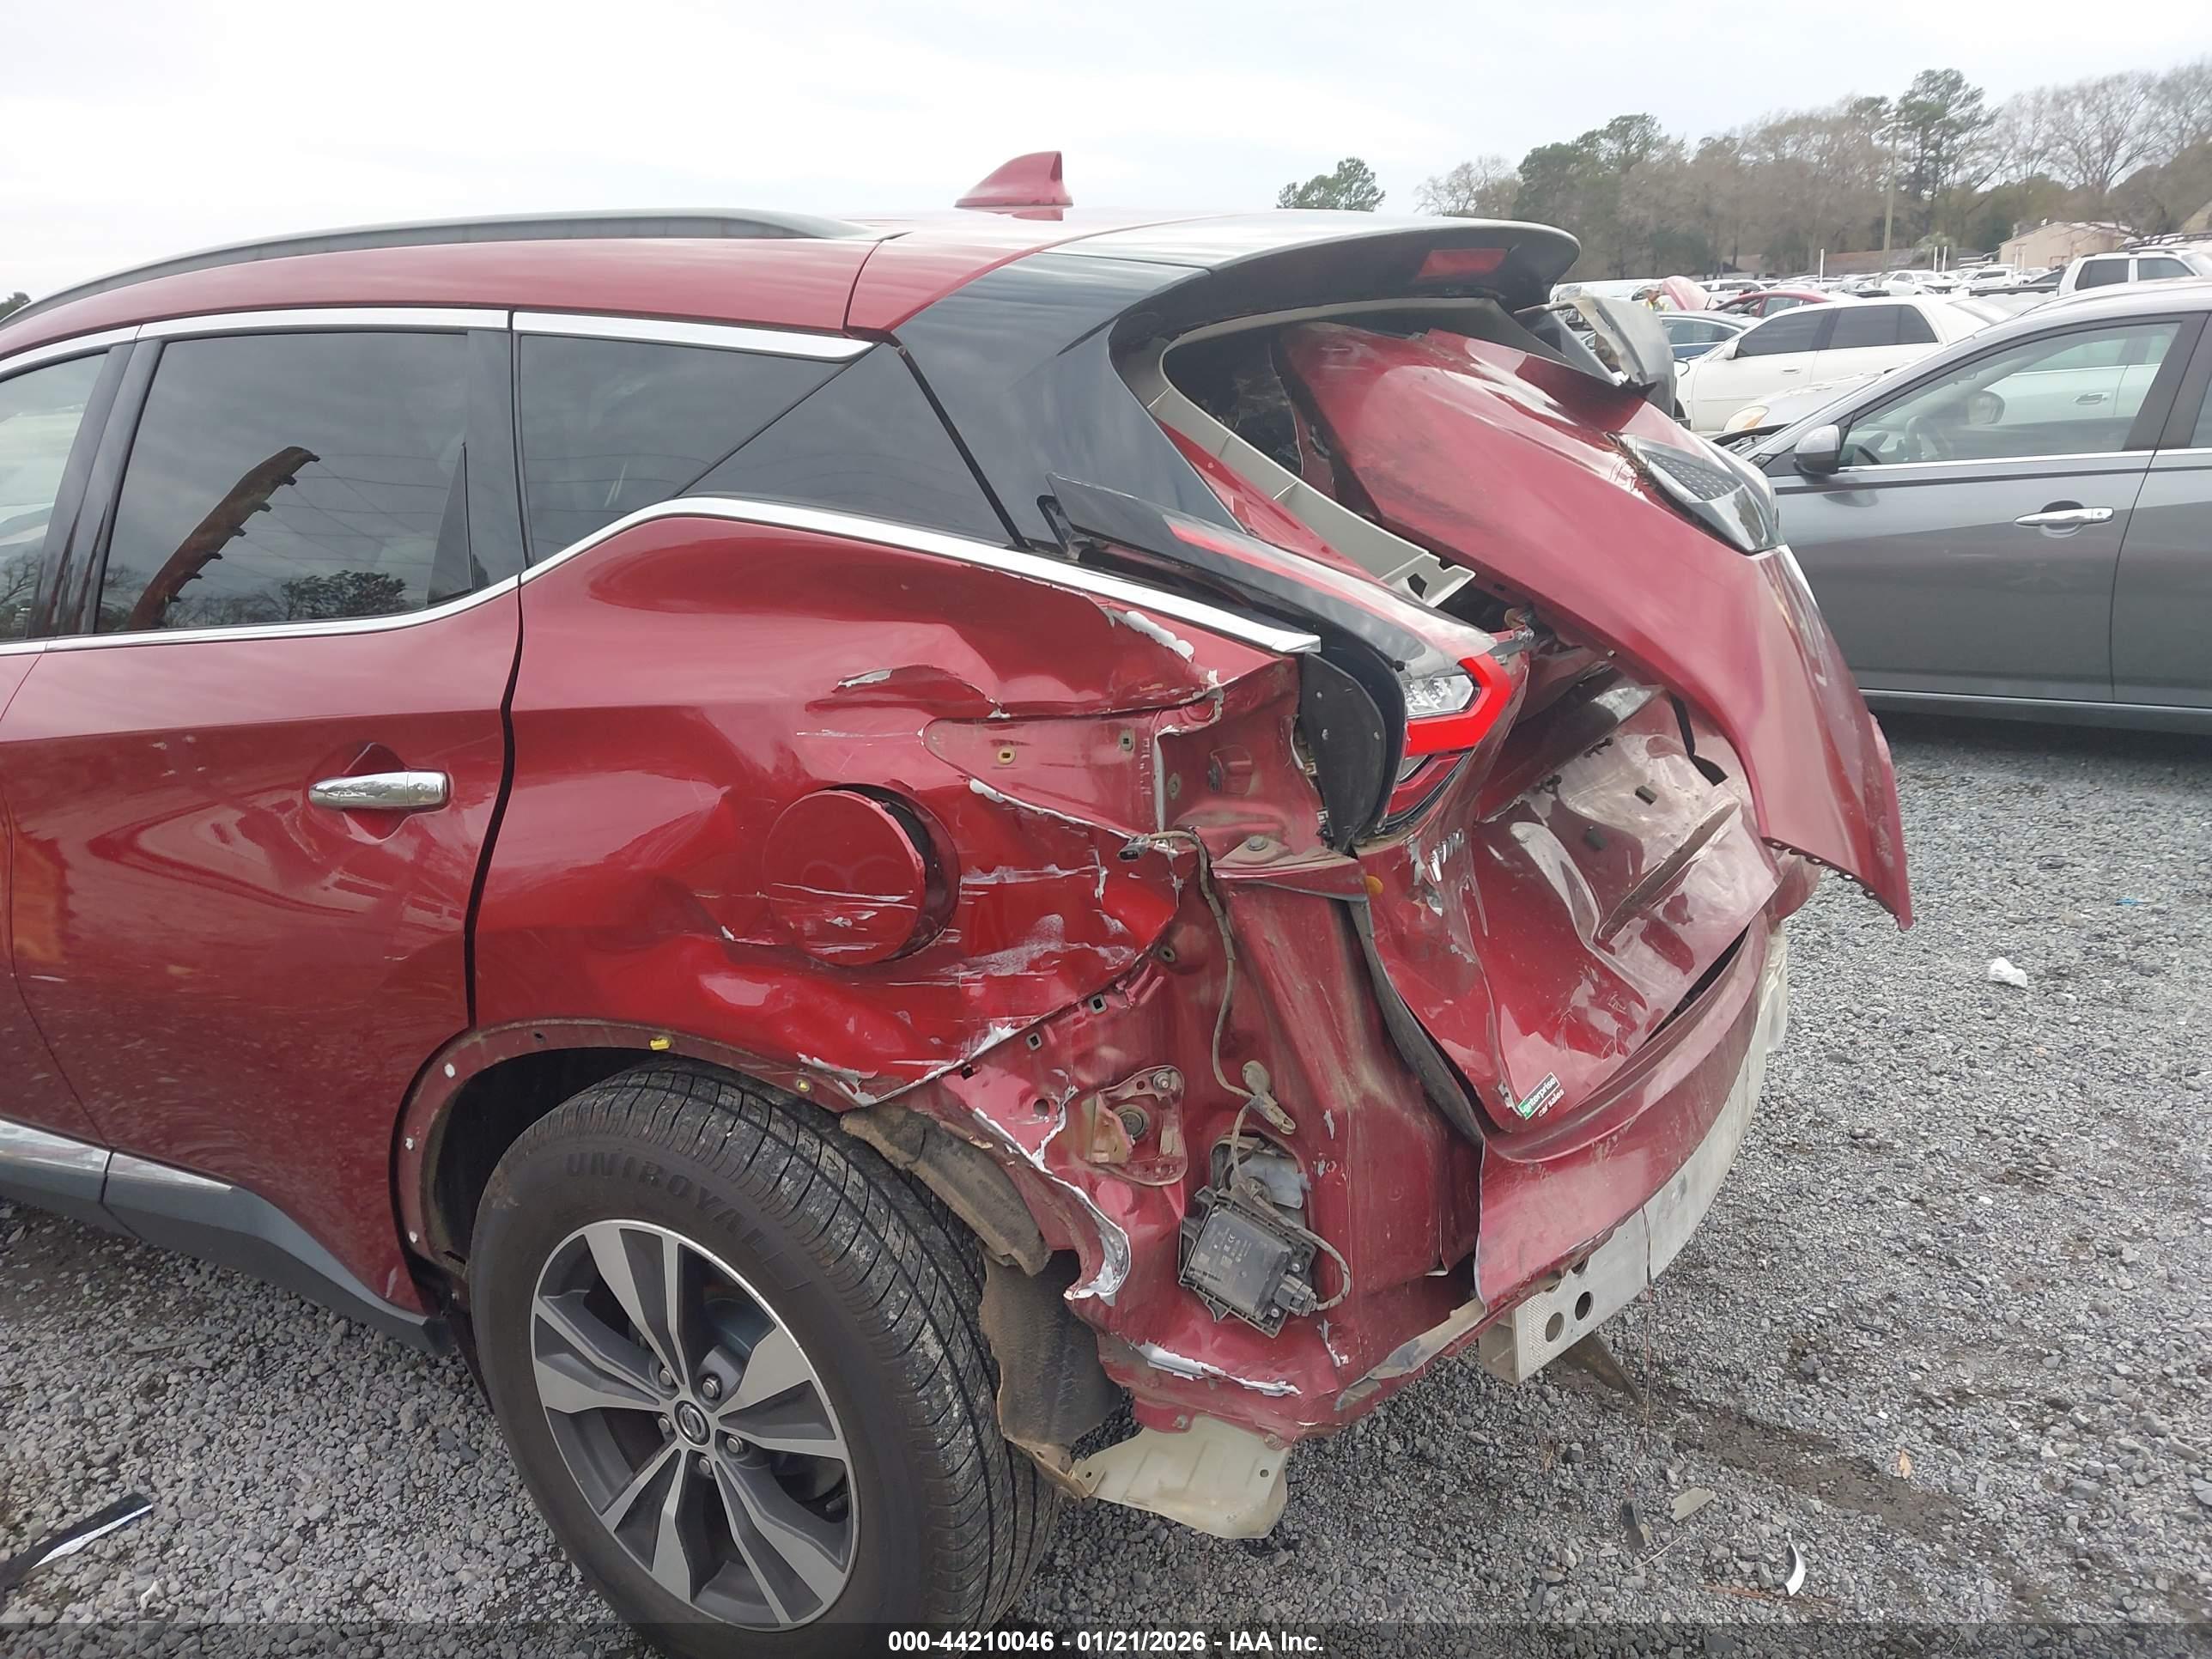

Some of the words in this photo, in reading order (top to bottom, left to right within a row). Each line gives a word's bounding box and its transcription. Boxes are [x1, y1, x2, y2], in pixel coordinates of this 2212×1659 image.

[1521, 1077, 1556, 1115] enterprise
[1538, 1103, 1549, 1117] car
[1548, 1089, 1565, 1107] sales
[565, 1152, 769, 1249] UNIROYAL
